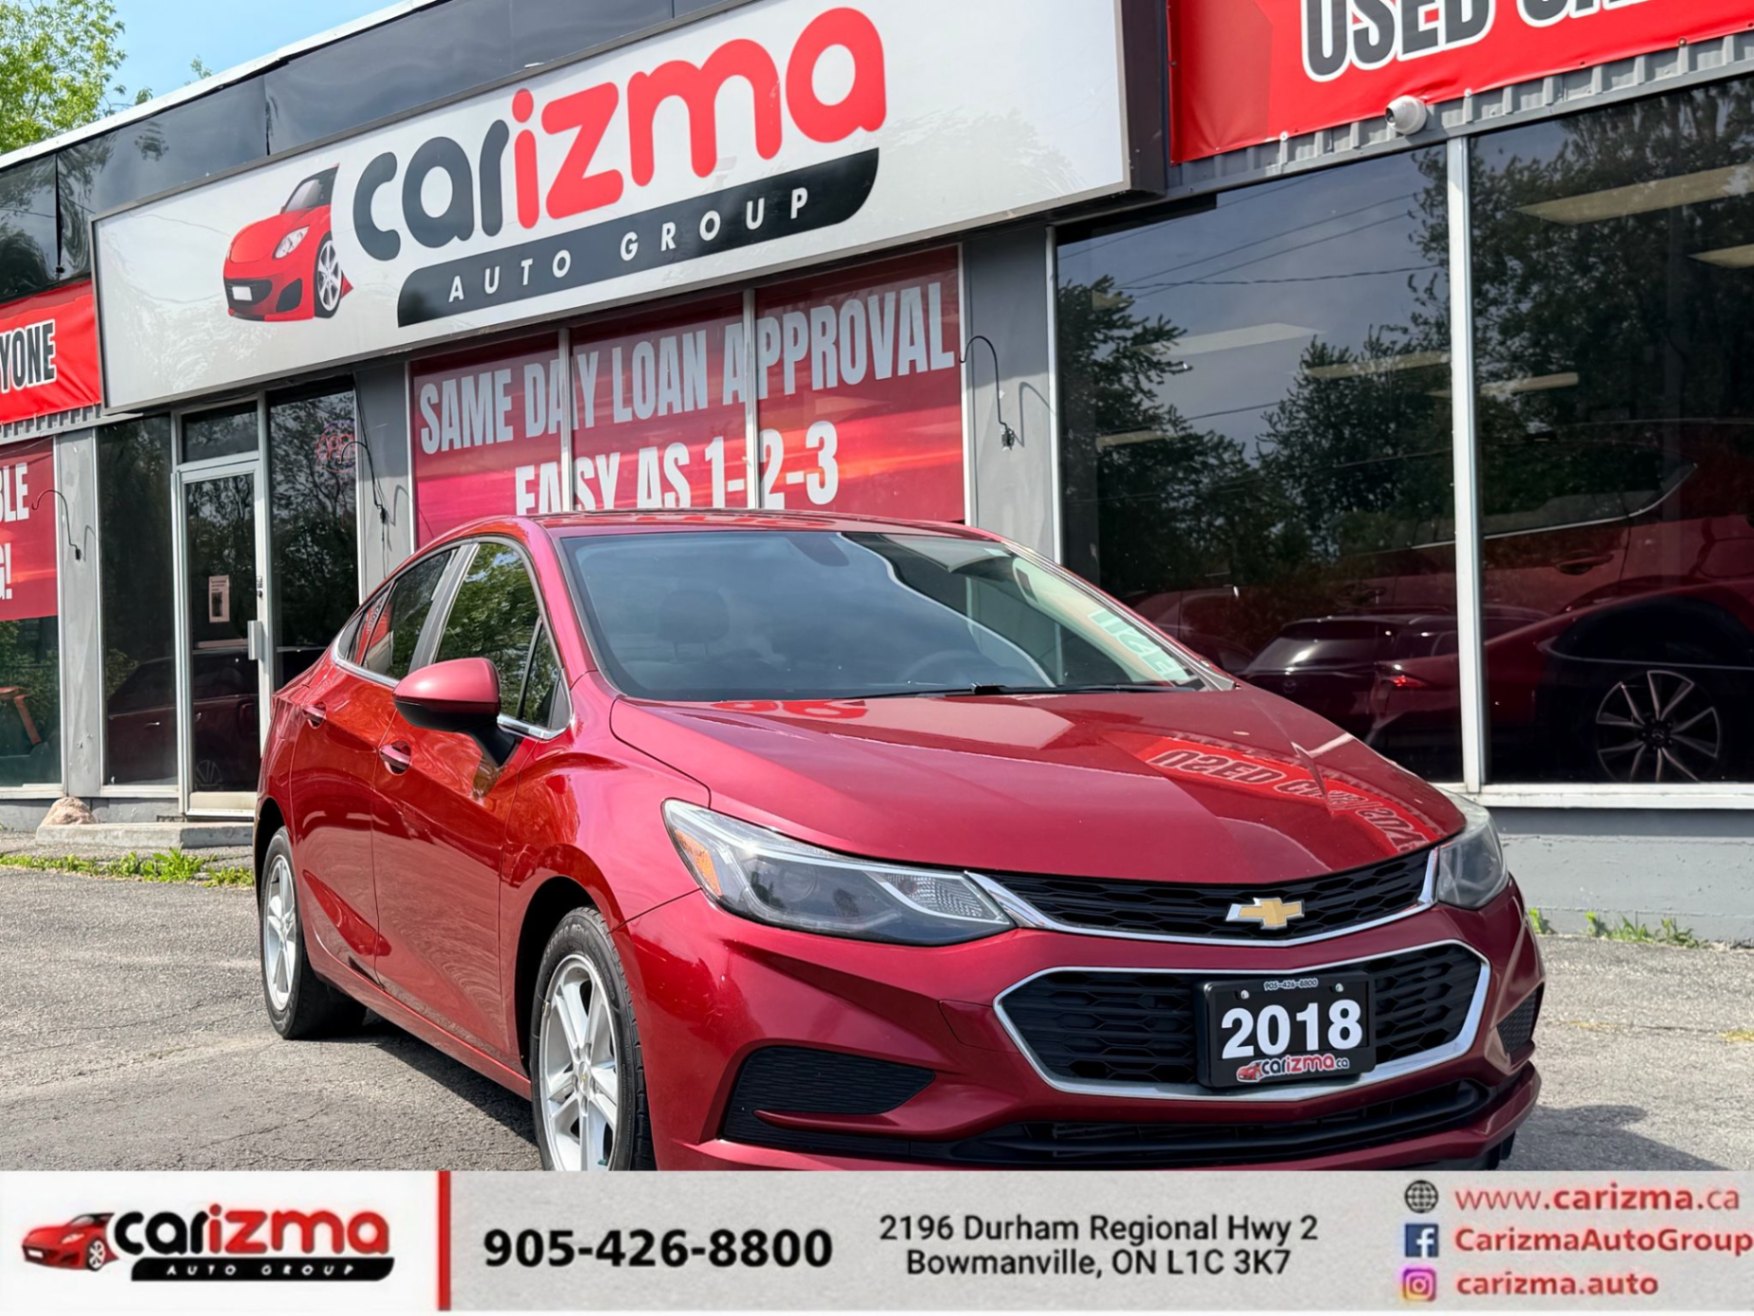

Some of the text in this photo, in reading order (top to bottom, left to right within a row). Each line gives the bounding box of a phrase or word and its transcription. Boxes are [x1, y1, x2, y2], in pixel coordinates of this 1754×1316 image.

[1303, 0, 1494, 81] USED
[353, 7, 887, 262] carizma
[448, 188, 808, 302] AUTO GROUP
[420, 368, 513, 454] SAME
[524, 351, 599, 438] DAY
[612, 329, 709, 424] LOAN
[723, 282, 955, 406] APPROVAL
[0, 462, 29, 522] LE
[516, 421, 839, 515] EASY AS 1-2-3
[1221, 999, 1363, 1060] 2018
